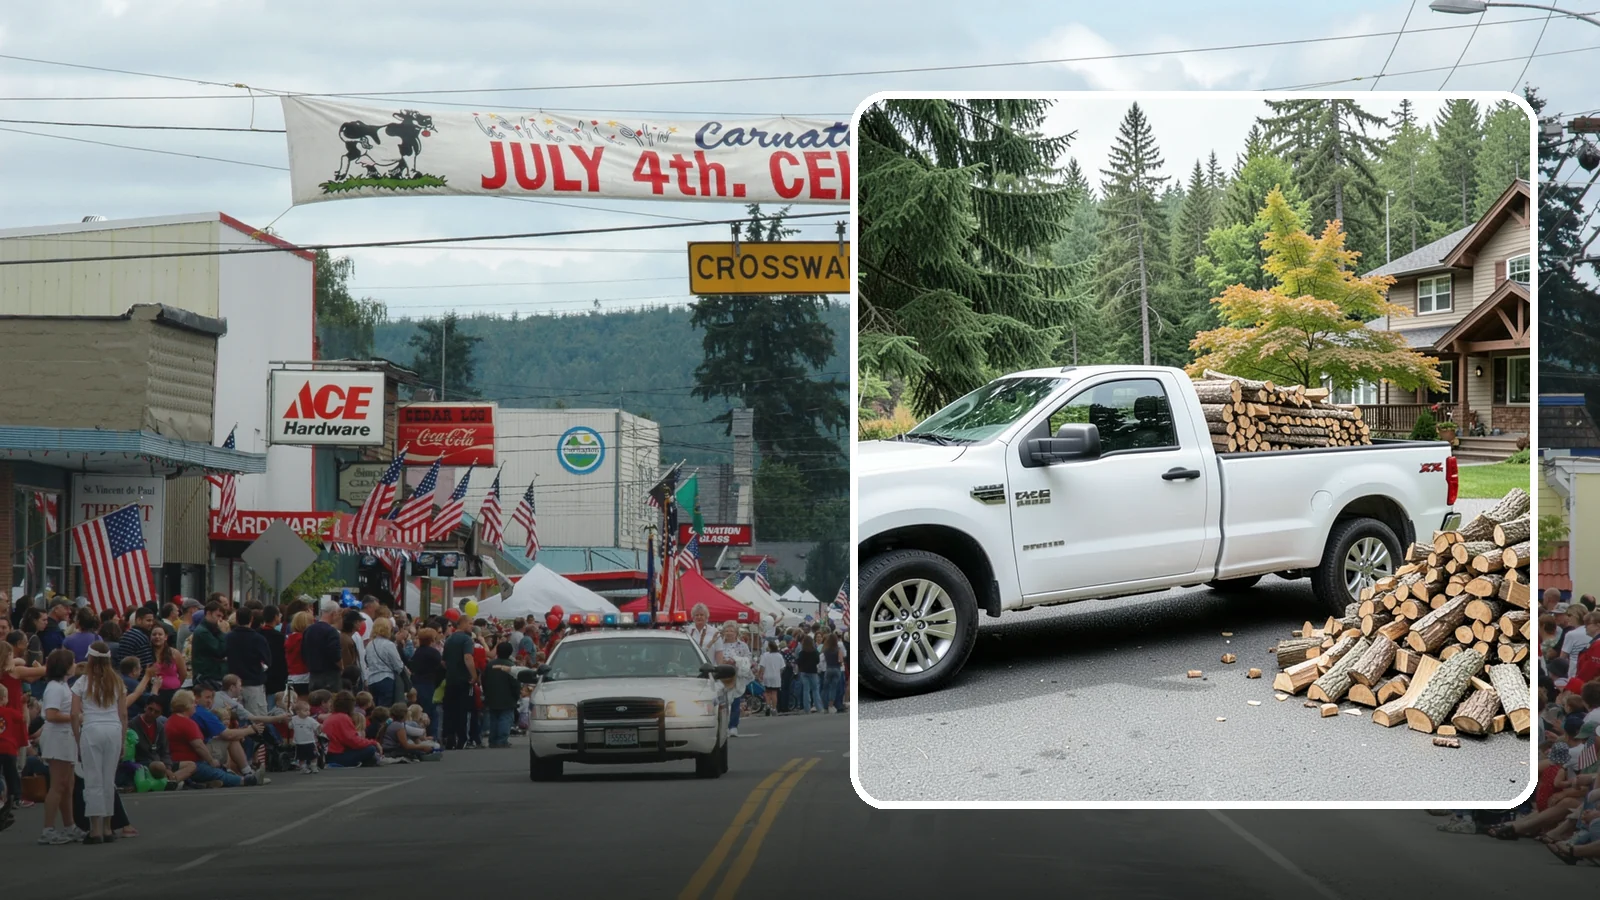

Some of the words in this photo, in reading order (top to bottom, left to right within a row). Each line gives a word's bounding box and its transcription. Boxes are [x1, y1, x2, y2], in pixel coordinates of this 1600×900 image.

[695, 121, 850, 149] Carnat
[481, 141, 605, 193] JULY
[632, 149, 746, 198] 4th.
[697, 254, 850, 280] CROSSWA
[283, 380, 373, 420] ACE
[406, 409, 452, 422] CEDAR
[283, 421, 371, 437] Hardware
[416, 428, 476, 447] Coca-Cola
[353, 466, 386, 481] Simpl
[83, 486, 93, 494] St.
[96, 485, 124, 494] Vincent
[126, 486, 136, 495] de
[138, 486, 155, 495] Paul
[81, 503, 154, 522] THT
[212, 516, 330, 535] HARDARE
[688, 526, 741, 535] CRNATION
[699, 535, 730, 543] GLASS
